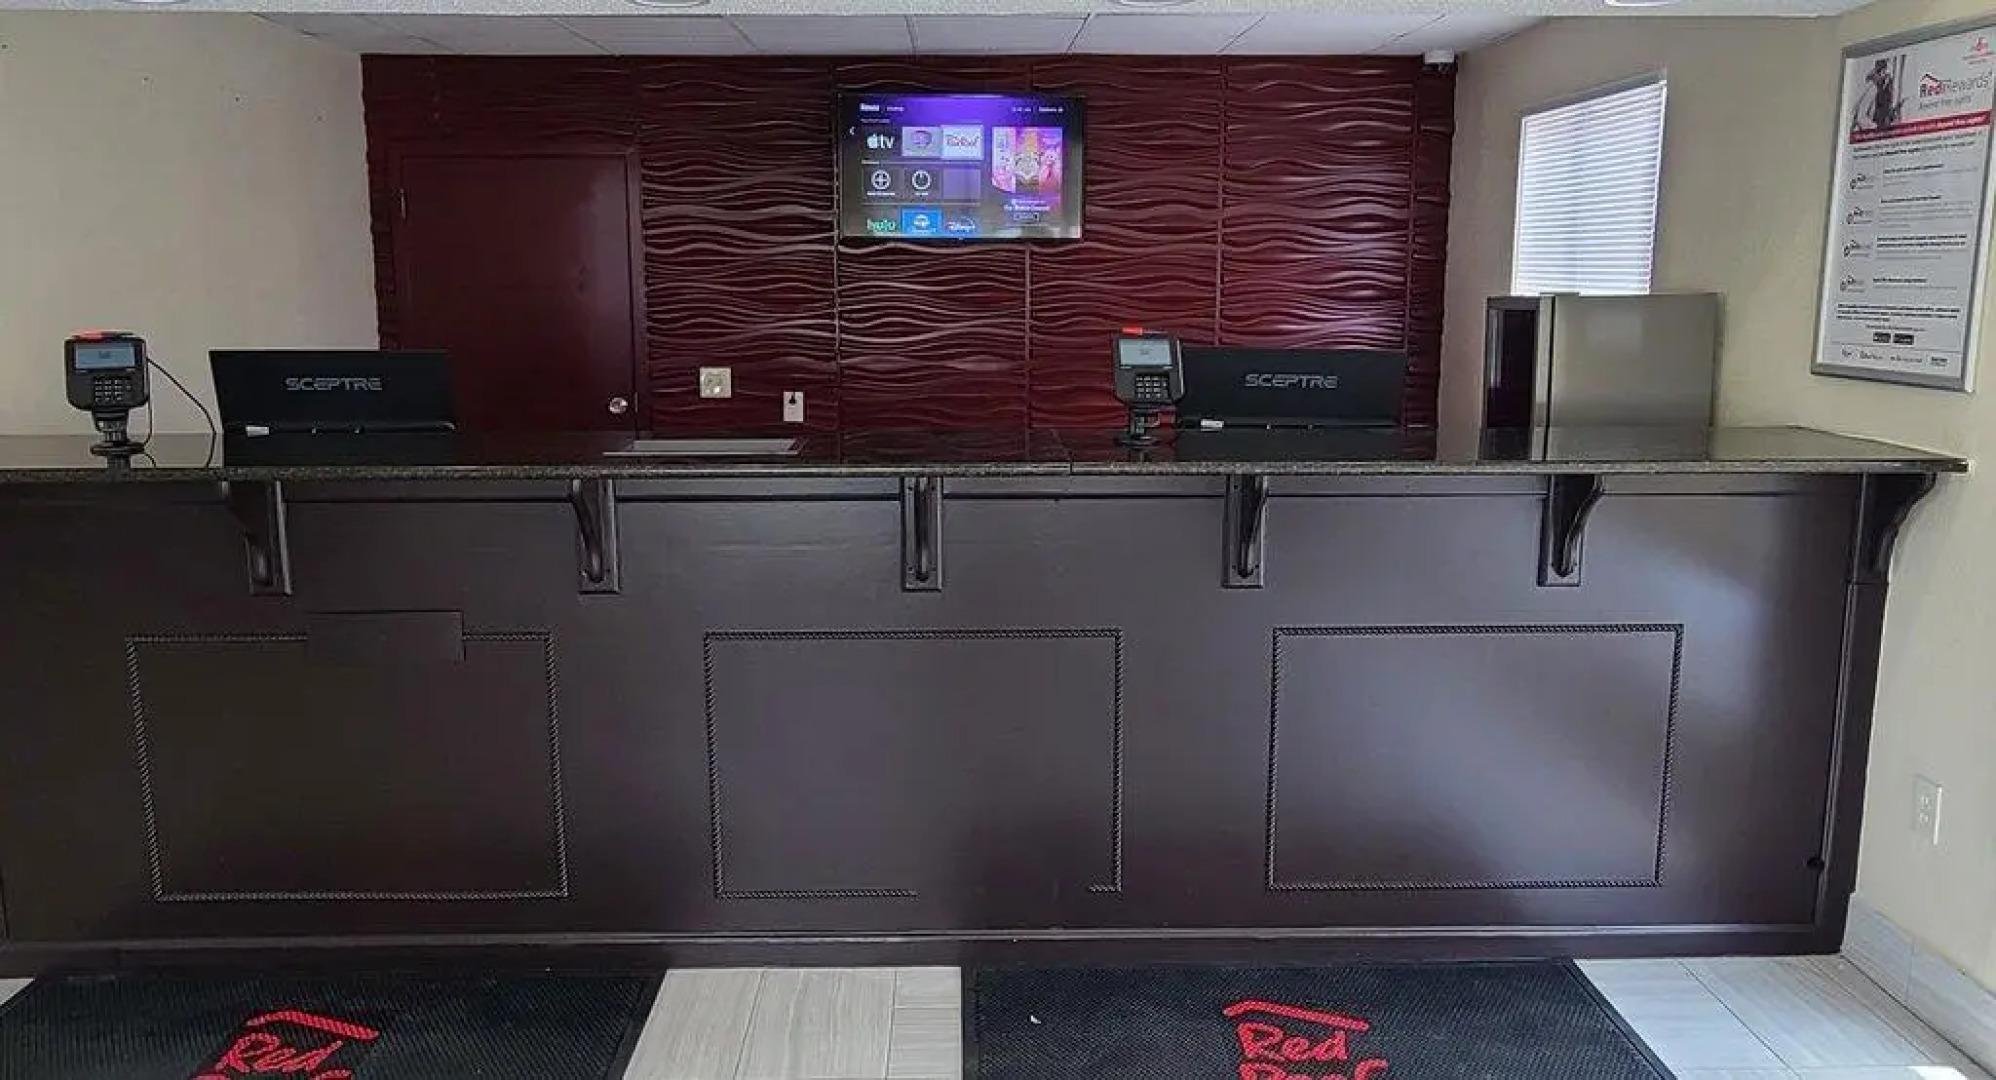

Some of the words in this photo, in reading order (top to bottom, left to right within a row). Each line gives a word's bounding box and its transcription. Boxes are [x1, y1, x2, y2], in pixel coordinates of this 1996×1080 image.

[285, 377, 383, 391] SCEPTRE
[1245, 373, 1339, 389] SCEPTRE
[214, 1032, 344, 1074] Red
[1237, 1022, 1349, 1061] Red
